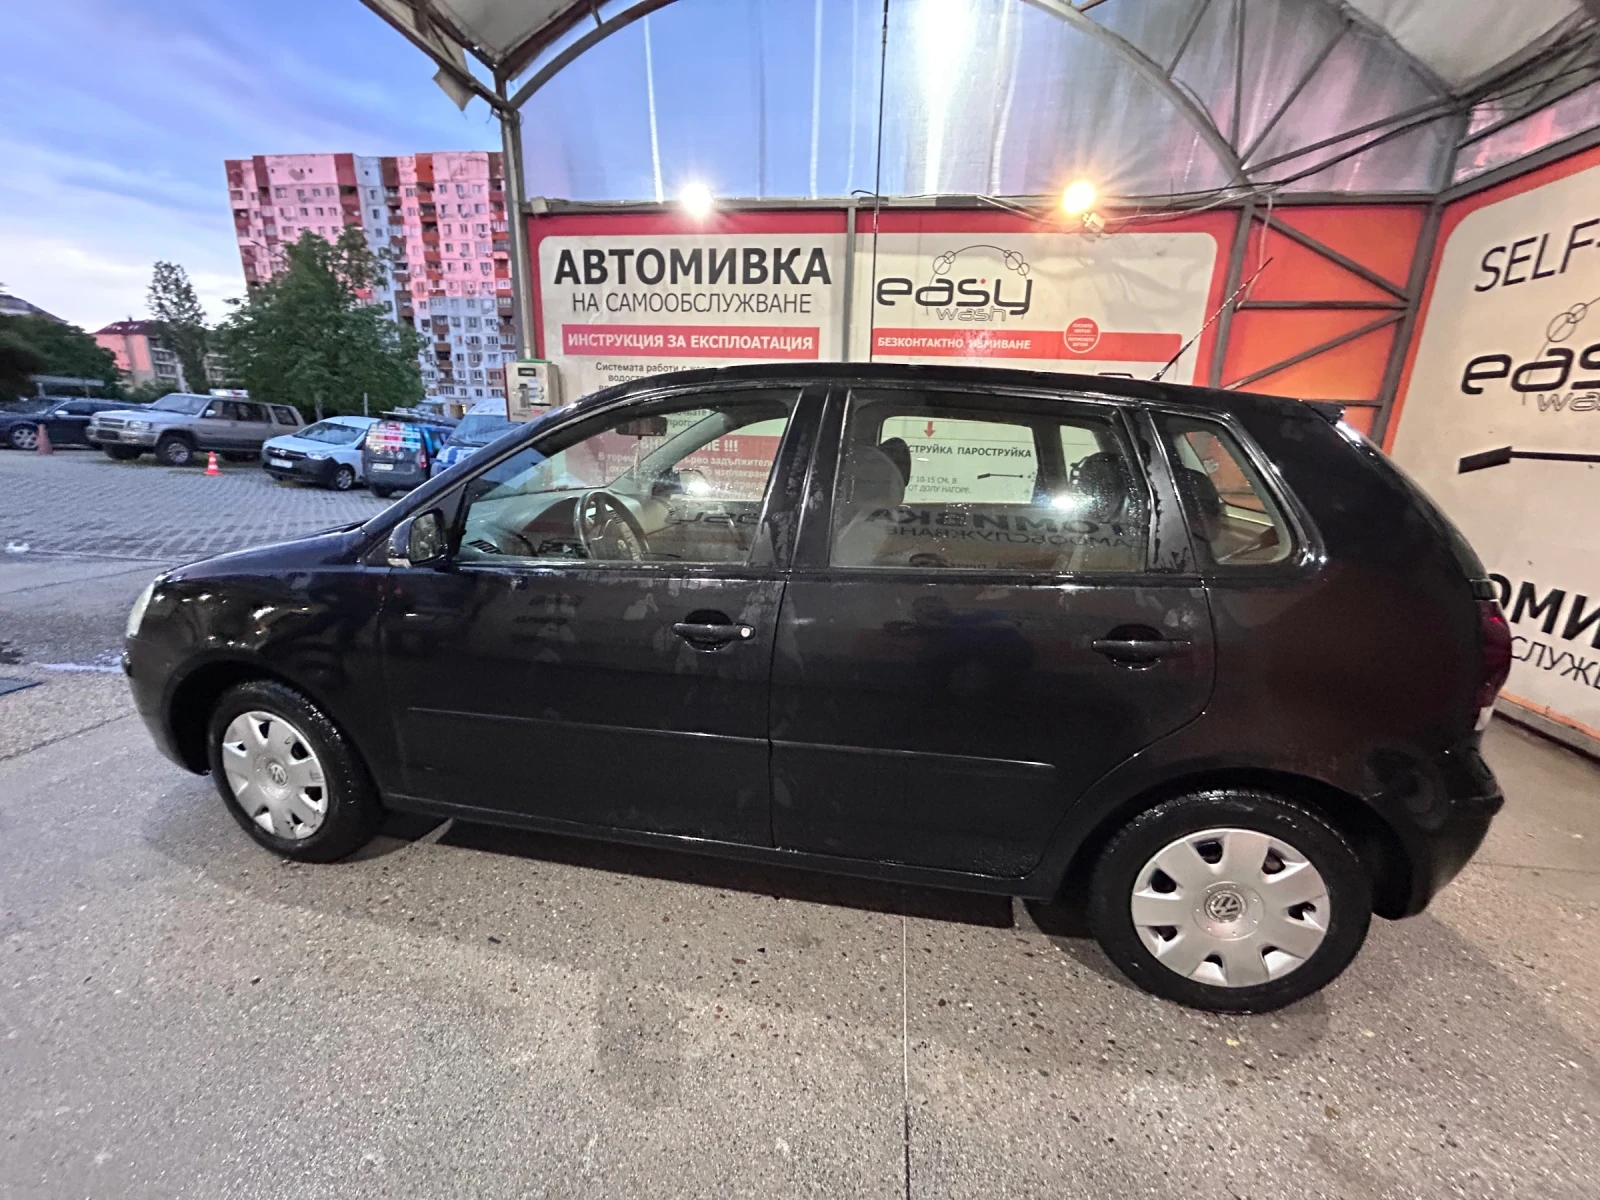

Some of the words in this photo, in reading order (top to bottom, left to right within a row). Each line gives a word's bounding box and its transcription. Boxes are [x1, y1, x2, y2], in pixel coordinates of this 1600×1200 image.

[554, 248, 832, 285] АВТОМИВКА
[572, 293, 599, 312] НА
[605, 293, 812, 314] САМООБСЛУЖВАНЕ
[877, 278, 1033, 316] easy
[936, 306, 1007, 322] wash
[568, 333, 664, 352] ИНСТРУКЦИЯ
[667, 335, 686, 350] ЗА
[691, 335, 814, 353] ЕКСПЛОАТАЦИЯ
[877, 337, 964, 349] БЕЗКОНТАКТНО
[969, 339, 1031, 350] ИЗМИВАНЕ
[595, 362, 644, 371] Системата
[646, 363, 679, 373] работи
[957, 446, 1032, 458] ПАРОСТРУЙКА
